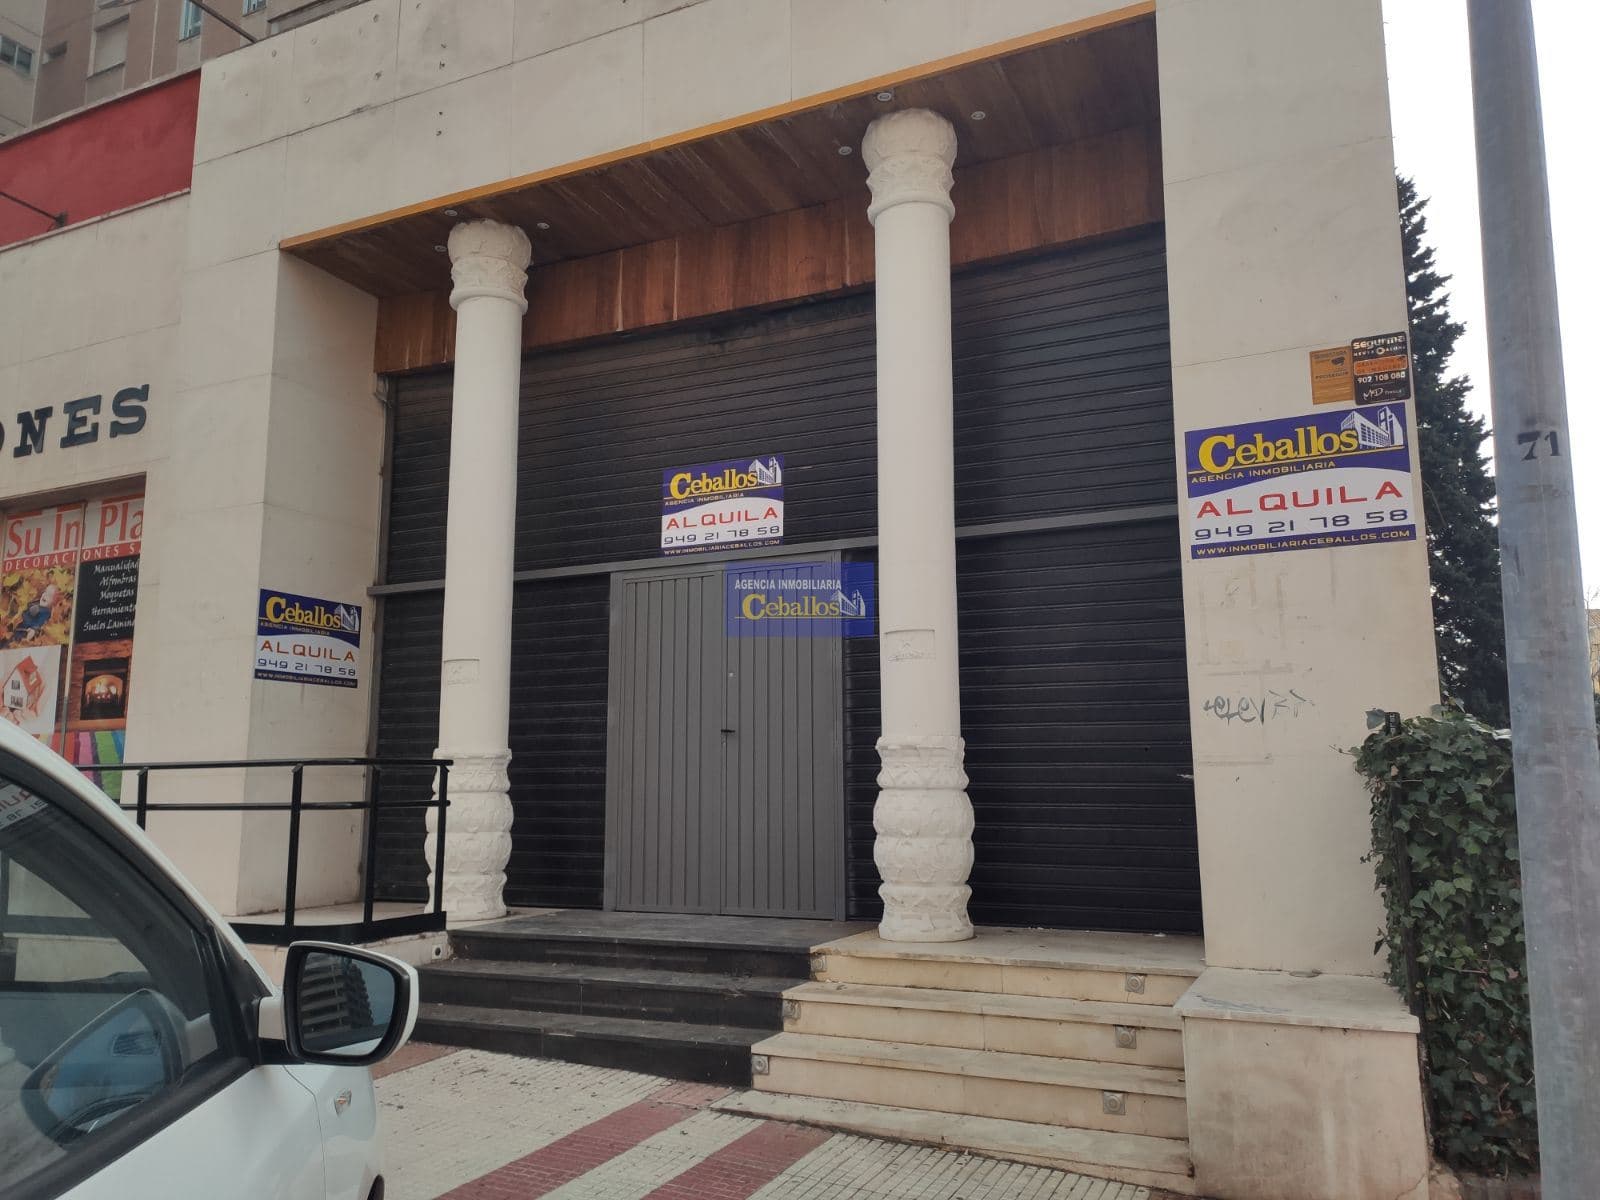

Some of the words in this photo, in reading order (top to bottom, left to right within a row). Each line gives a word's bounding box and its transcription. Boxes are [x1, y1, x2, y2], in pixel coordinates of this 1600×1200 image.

[0, 384, 149, 458] NES
[1199, 426, 1359, 473] Ceballos
[1517, 431, 1561, 461] 71
[670, 468, 758, 499] Ceballos
[1191, 471, 1244, 483] AGENCIA
[1250, 461, 1336, 477] INMOBILIARIA
[1197, 481, 1403, 519] ALQUILA
[666, 506, 778, 530] ALQUILA
[1195, 524, 1253, 540] 949
[1268, 520, 1295, 533] 21
[1310, 514, 1350, 528] 78
[1366, 509, 1408, 524] 58
[6, 518, 42, 558] Su
[664, 534, 697, 545] 949
[705, 532, 719, 541] 21
[727, 528, 748, 537] 78
[758, 525, 780, 535] 58
[1197, 530, 1410, 555] WWW.INMOBILIARIACEBALLOS.COM
[266, 596, 342, 628] Ceballos
[260, 640, 355, 662] ALQUILA
[258, 658, 288, 669] 949
[295, 662, 308, 671] 21
[315, 665, 332, 673] 78
[338, 667, 356, 676] 58
